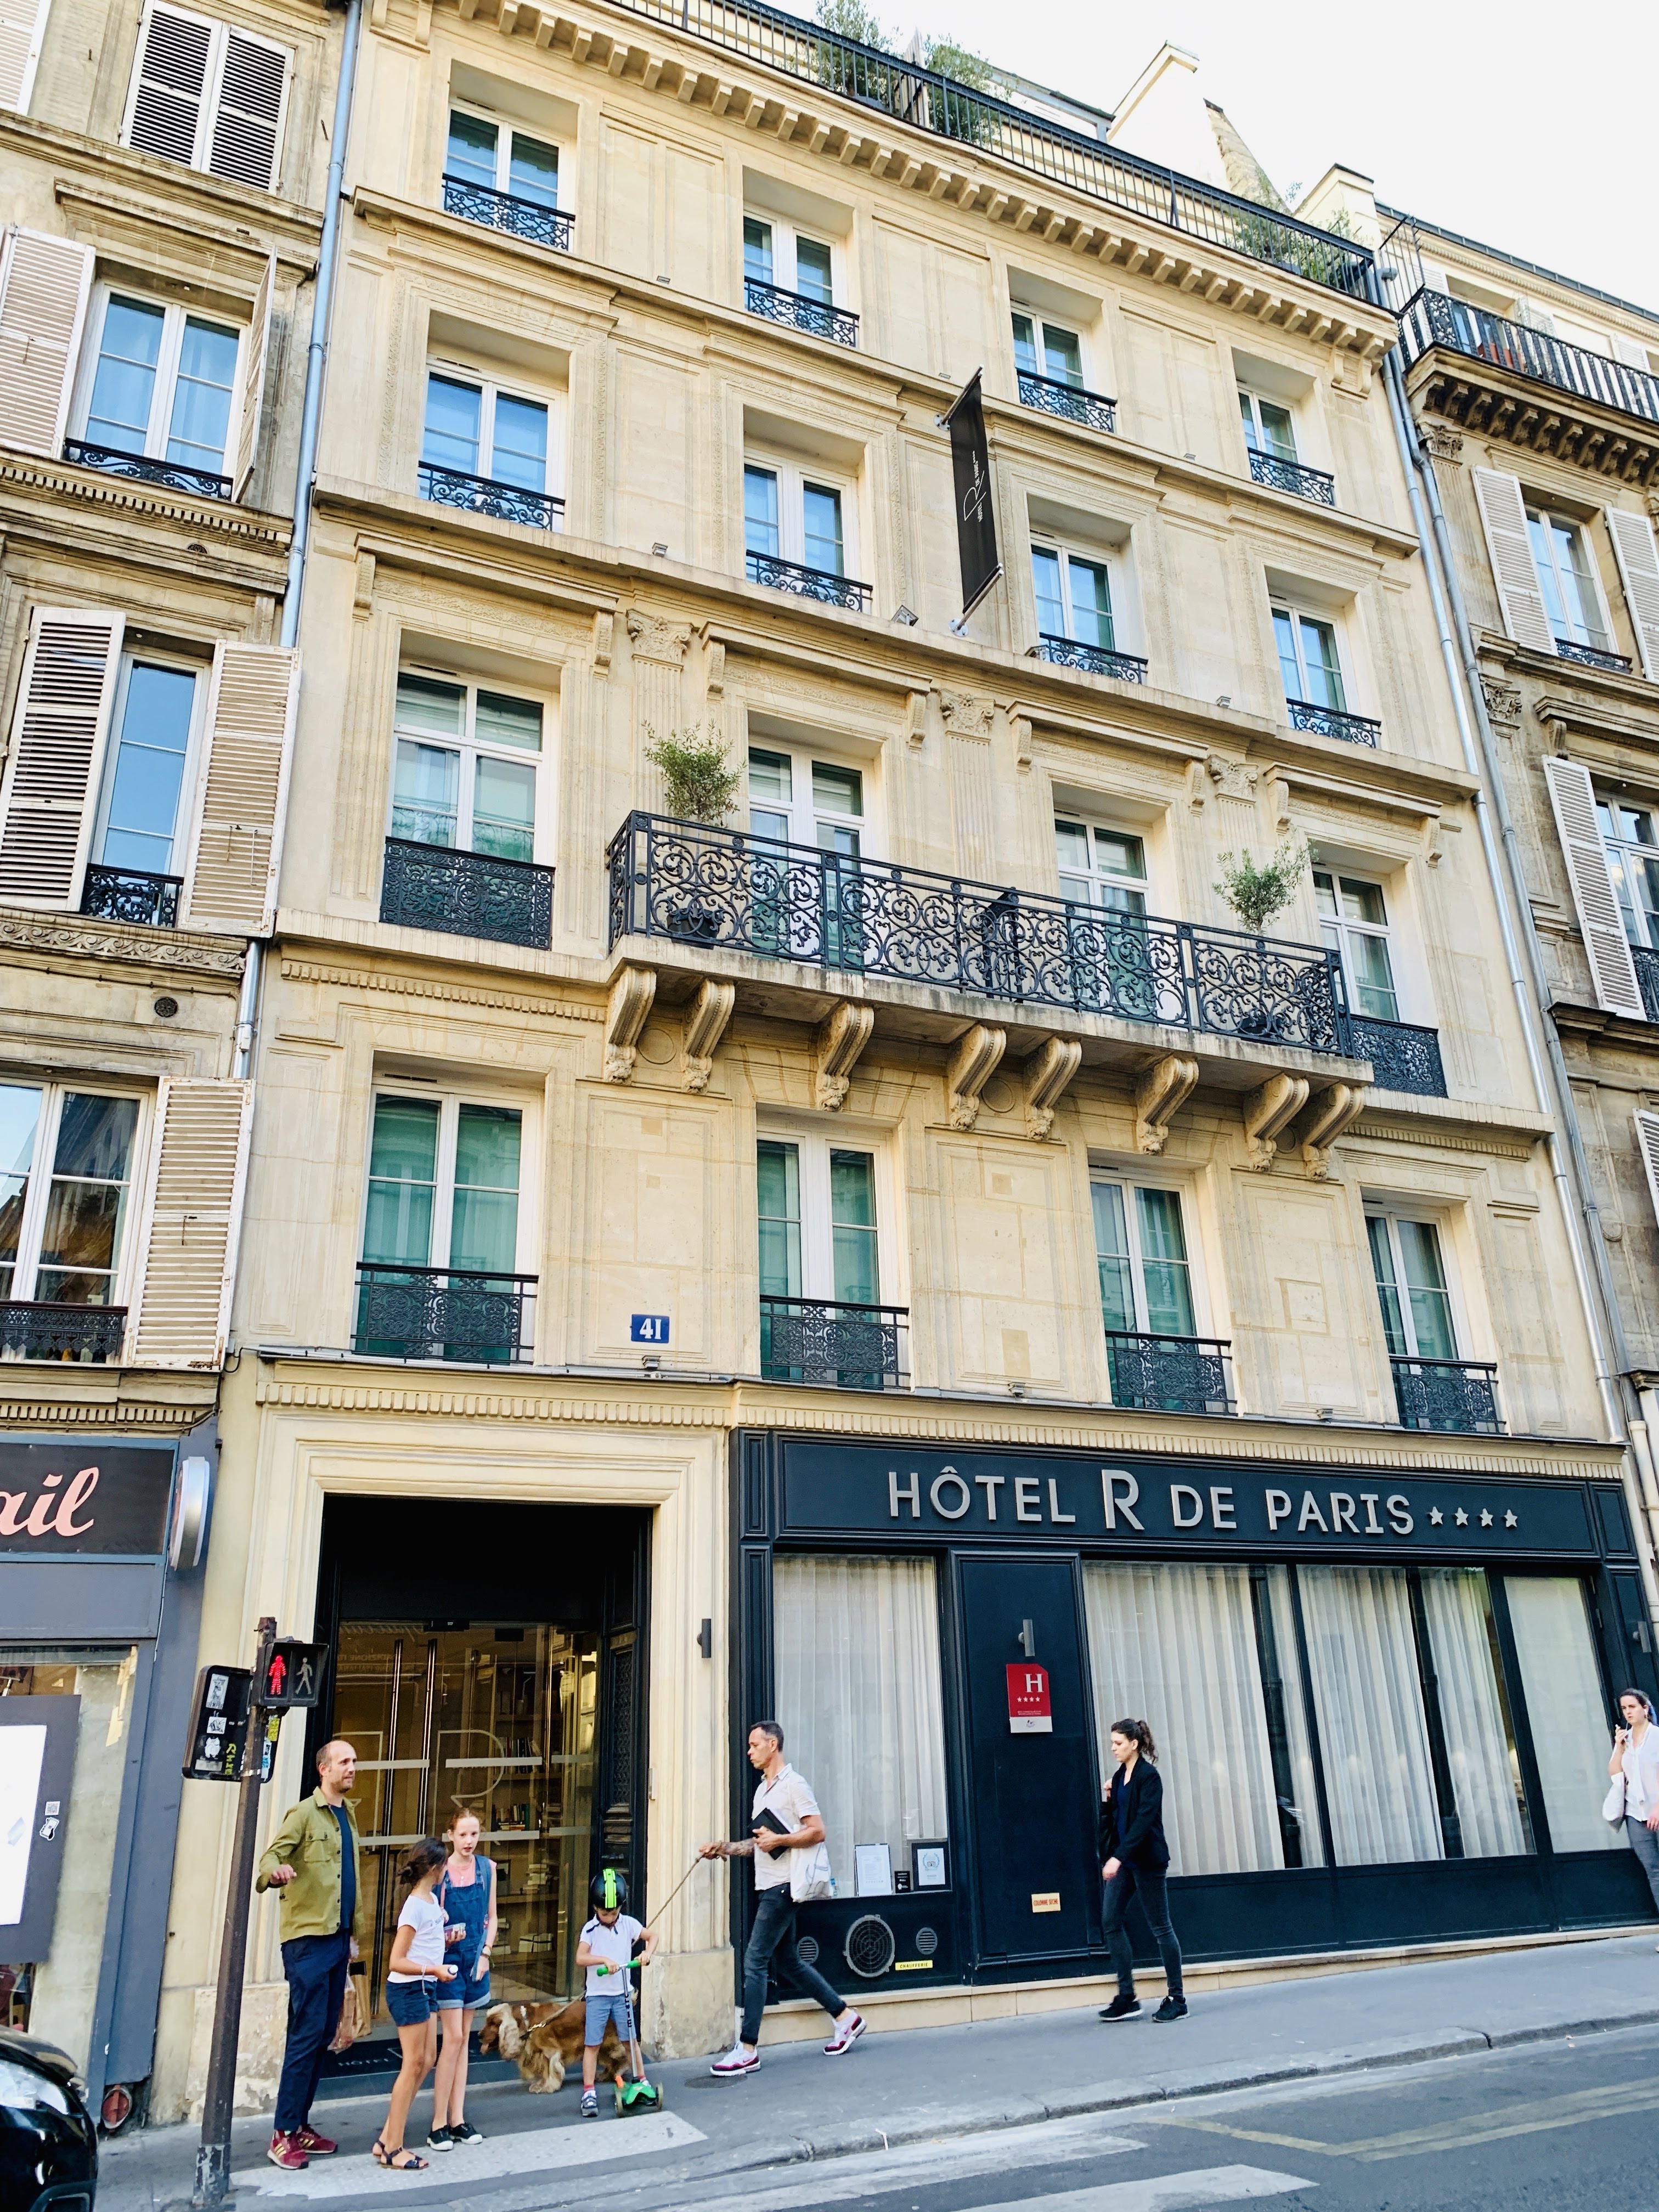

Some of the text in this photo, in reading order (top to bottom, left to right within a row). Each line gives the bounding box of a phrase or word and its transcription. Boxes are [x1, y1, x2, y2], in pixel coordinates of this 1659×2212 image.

[963, 470, 986, 521] R
[639, 1318, 662, 1340] 41
[889, 1466, 1414, 1535] HÔTEL R DE PARIS
[1024, 1673, 1045, 1693] H
